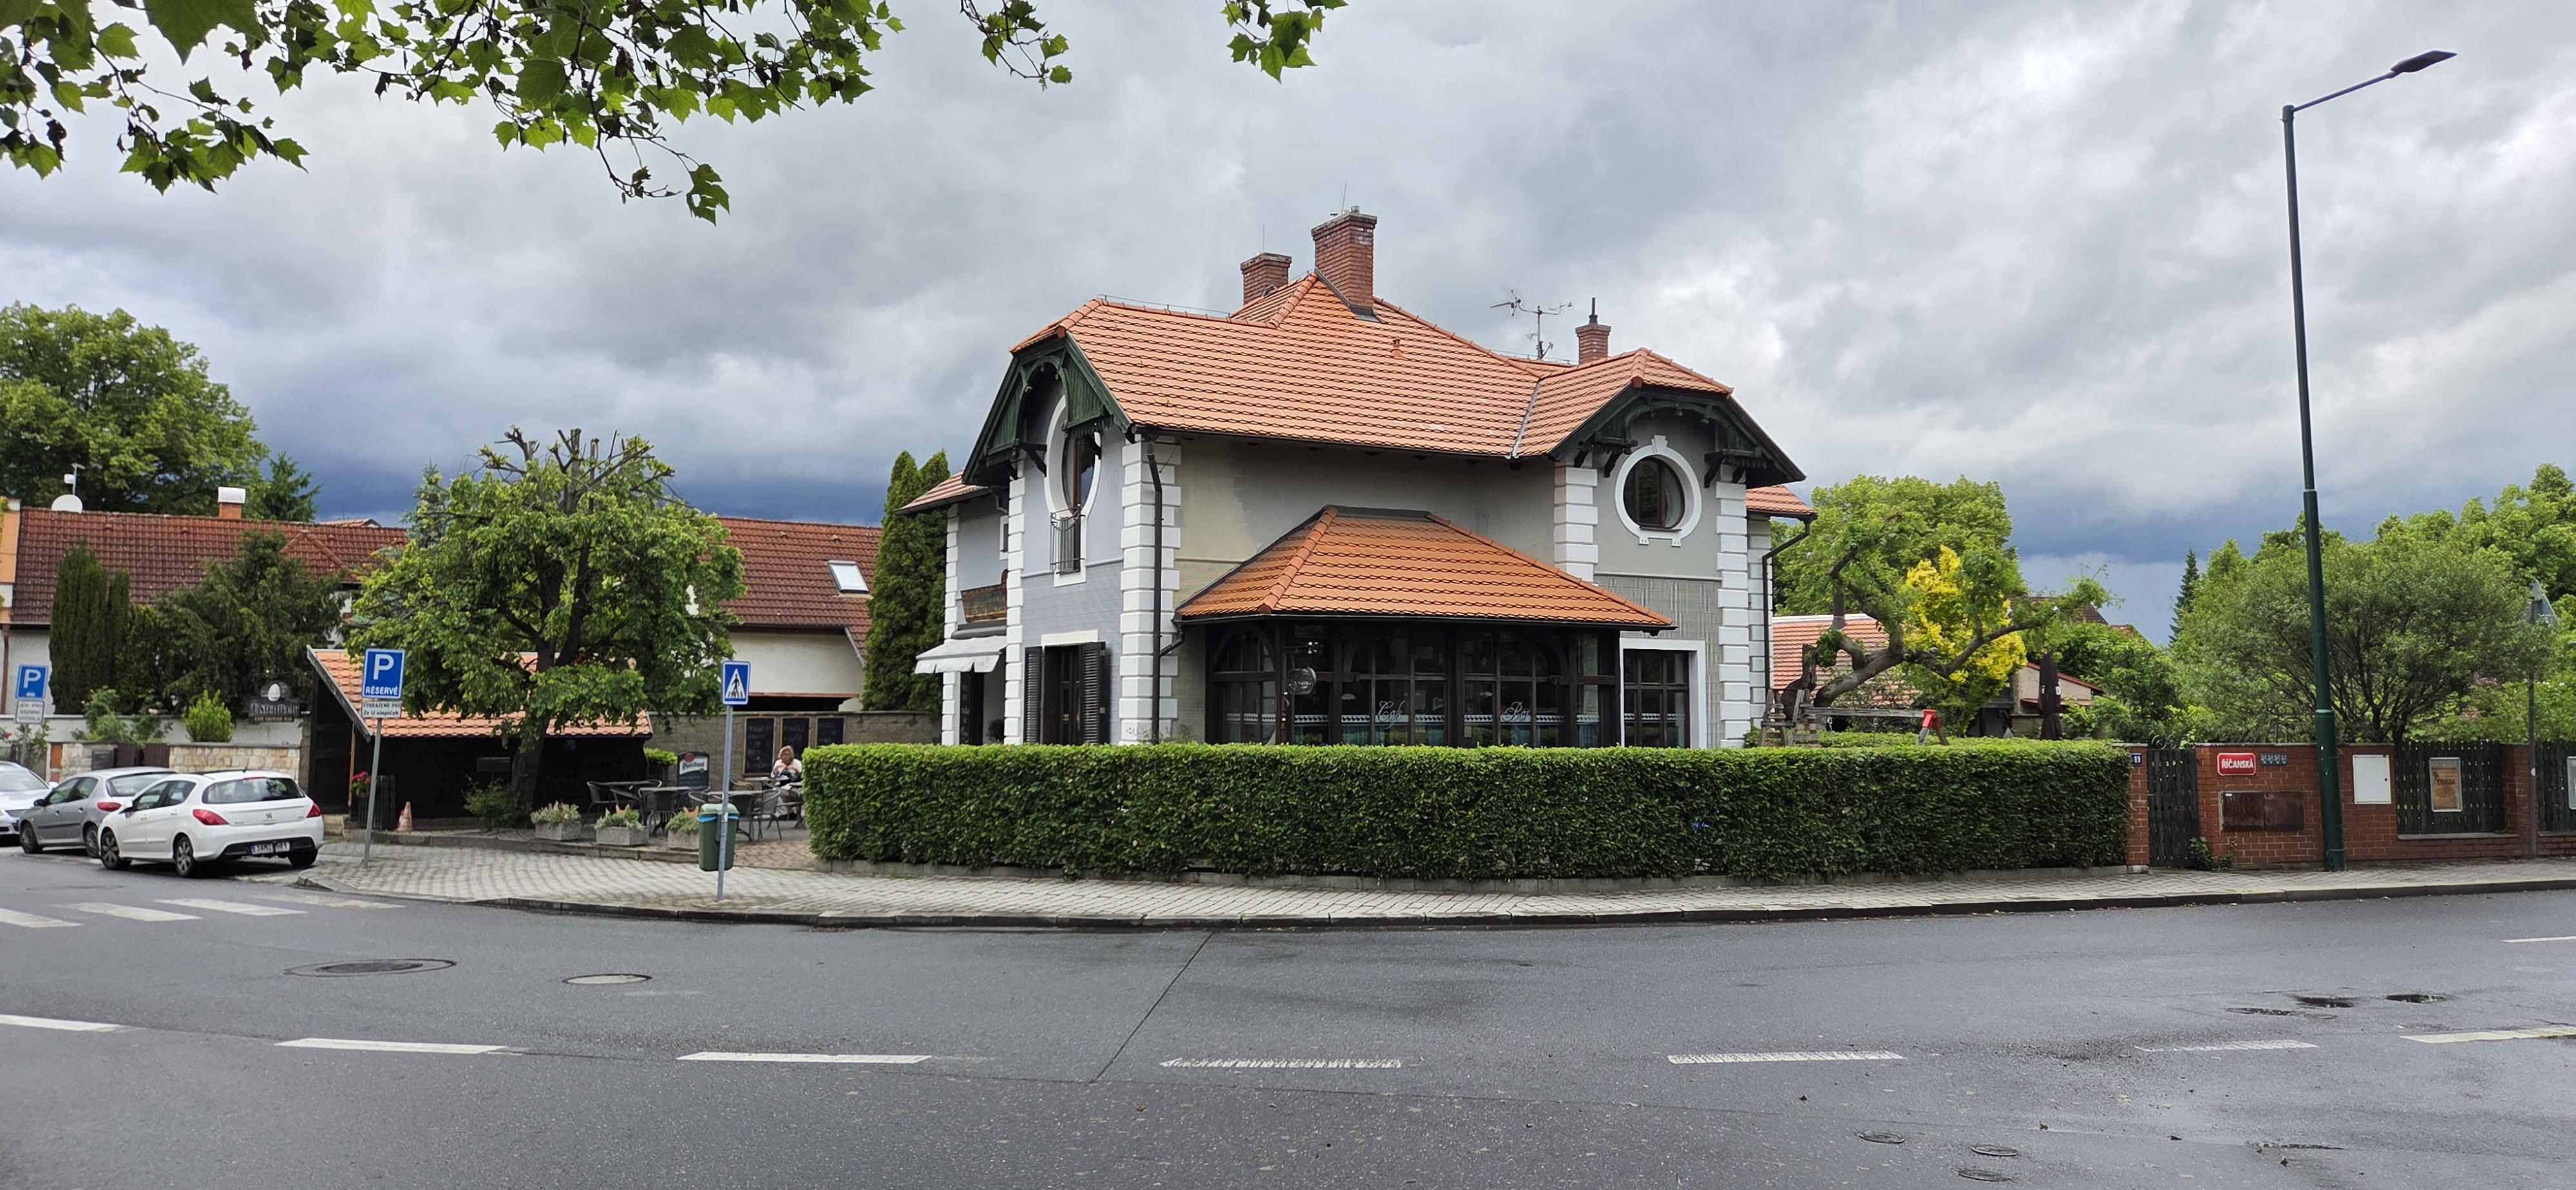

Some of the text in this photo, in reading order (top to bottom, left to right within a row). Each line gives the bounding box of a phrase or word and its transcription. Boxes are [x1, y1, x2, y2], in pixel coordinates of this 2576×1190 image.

[374, 654, 394, 680] P
[24, 669, 42, 689] P
[365, 685, 398, 695] RÉSERVÉ
[2221, 759, 2253, 769] ŘÍČANSKÁ
